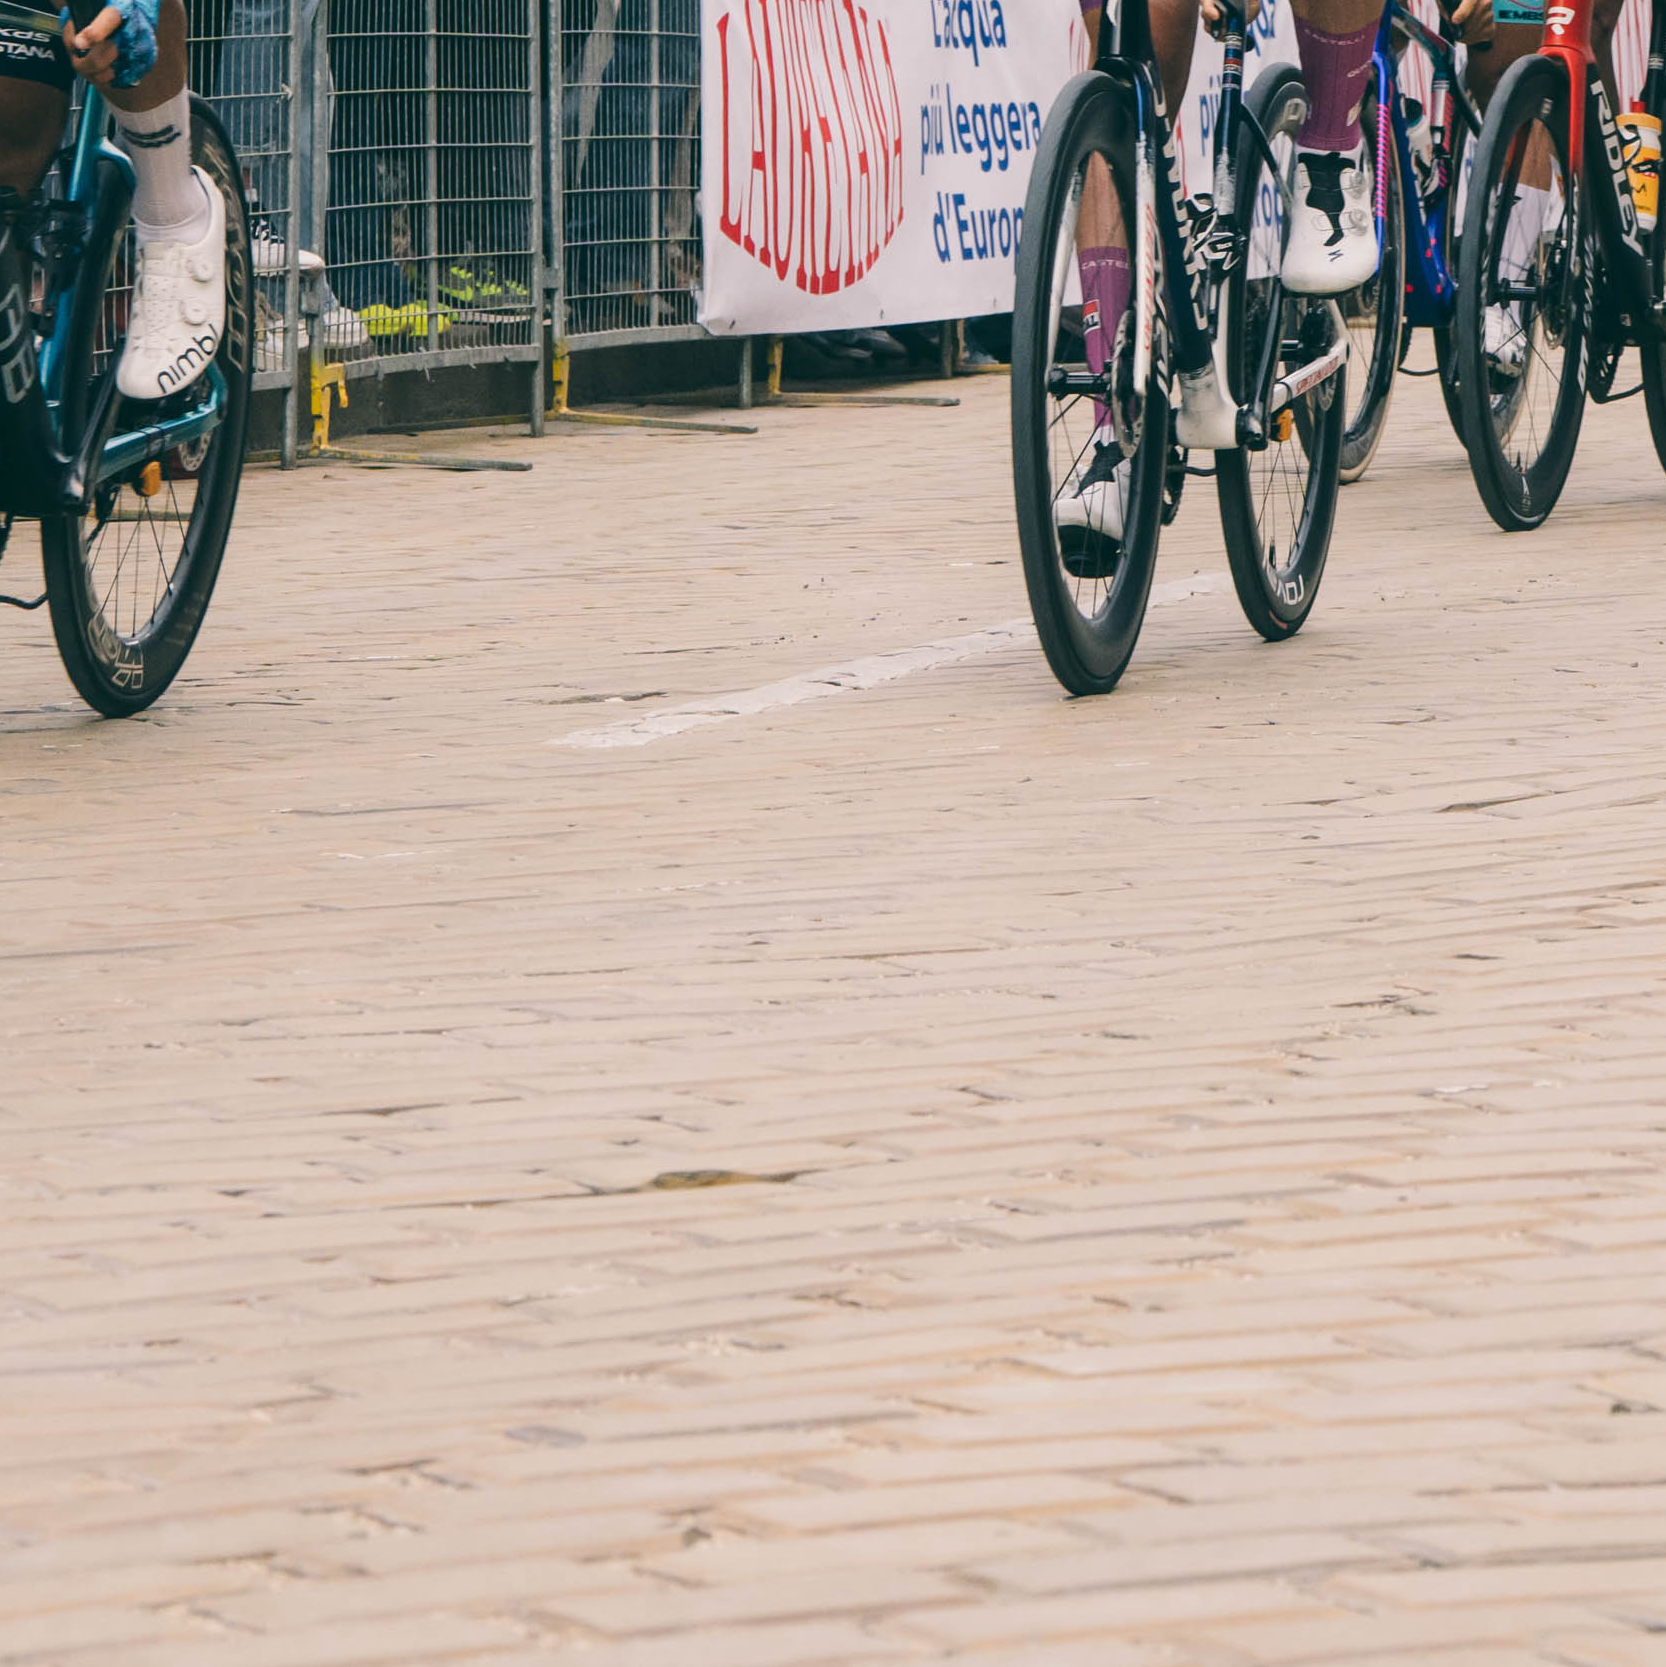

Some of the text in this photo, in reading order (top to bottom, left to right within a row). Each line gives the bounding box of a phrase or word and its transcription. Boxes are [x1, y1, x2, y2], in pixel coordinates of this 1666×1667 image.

[921, 84, 1042, 175] più leggera
[1589, 79, 1644, 256] RIDLEY
[932, 192, 1024, 263] d'Europ
